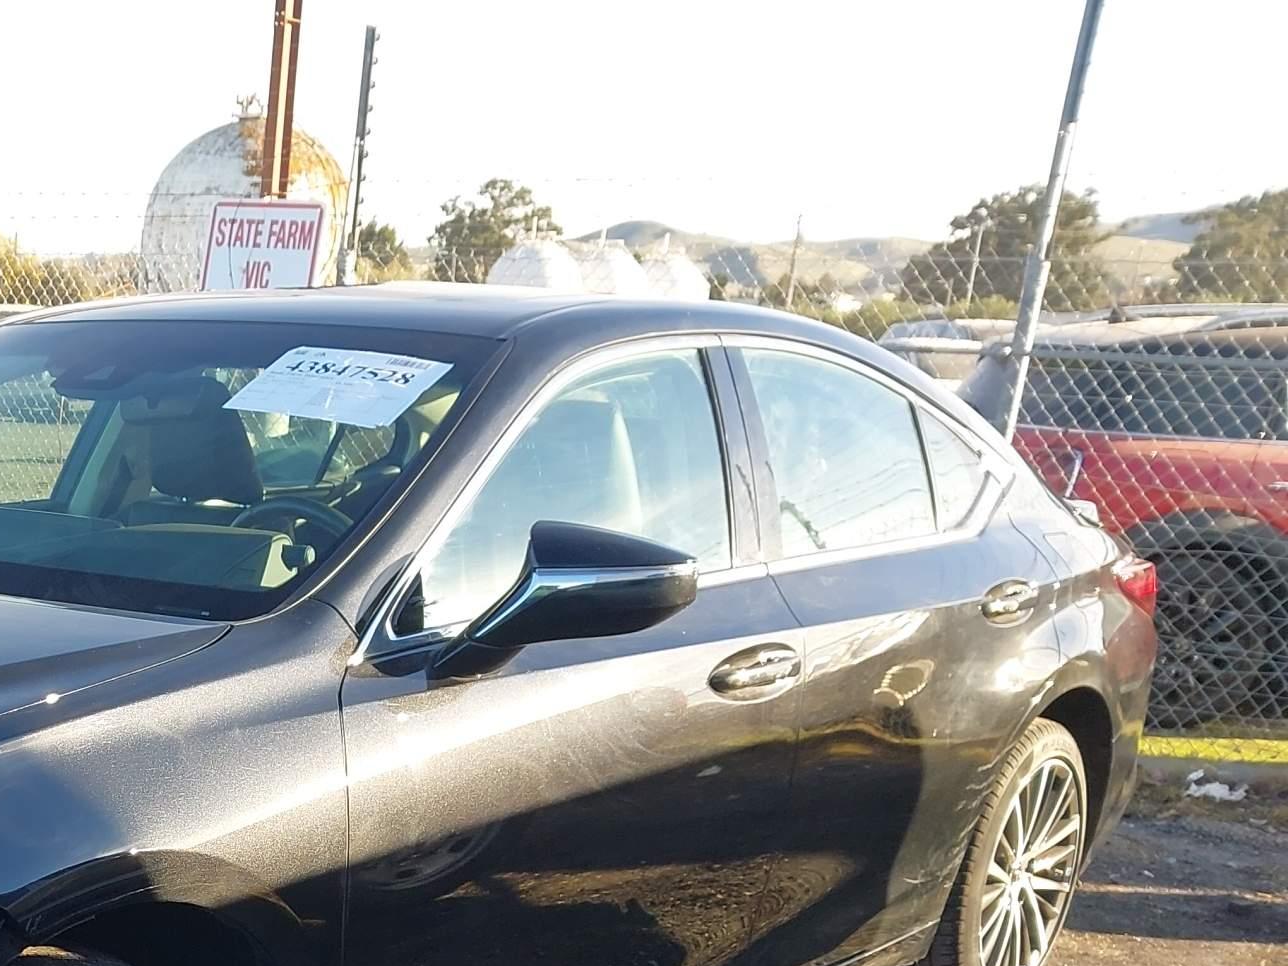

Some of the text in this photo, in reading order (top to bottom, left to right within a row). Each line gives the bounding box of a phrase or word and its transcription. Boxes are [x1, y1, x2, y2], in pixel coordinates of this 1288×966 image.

[215, 217, 315, 251] STATE FARM
[244, 260, 272, 289] VIC
[285, 359, 416, 386] 43847528
